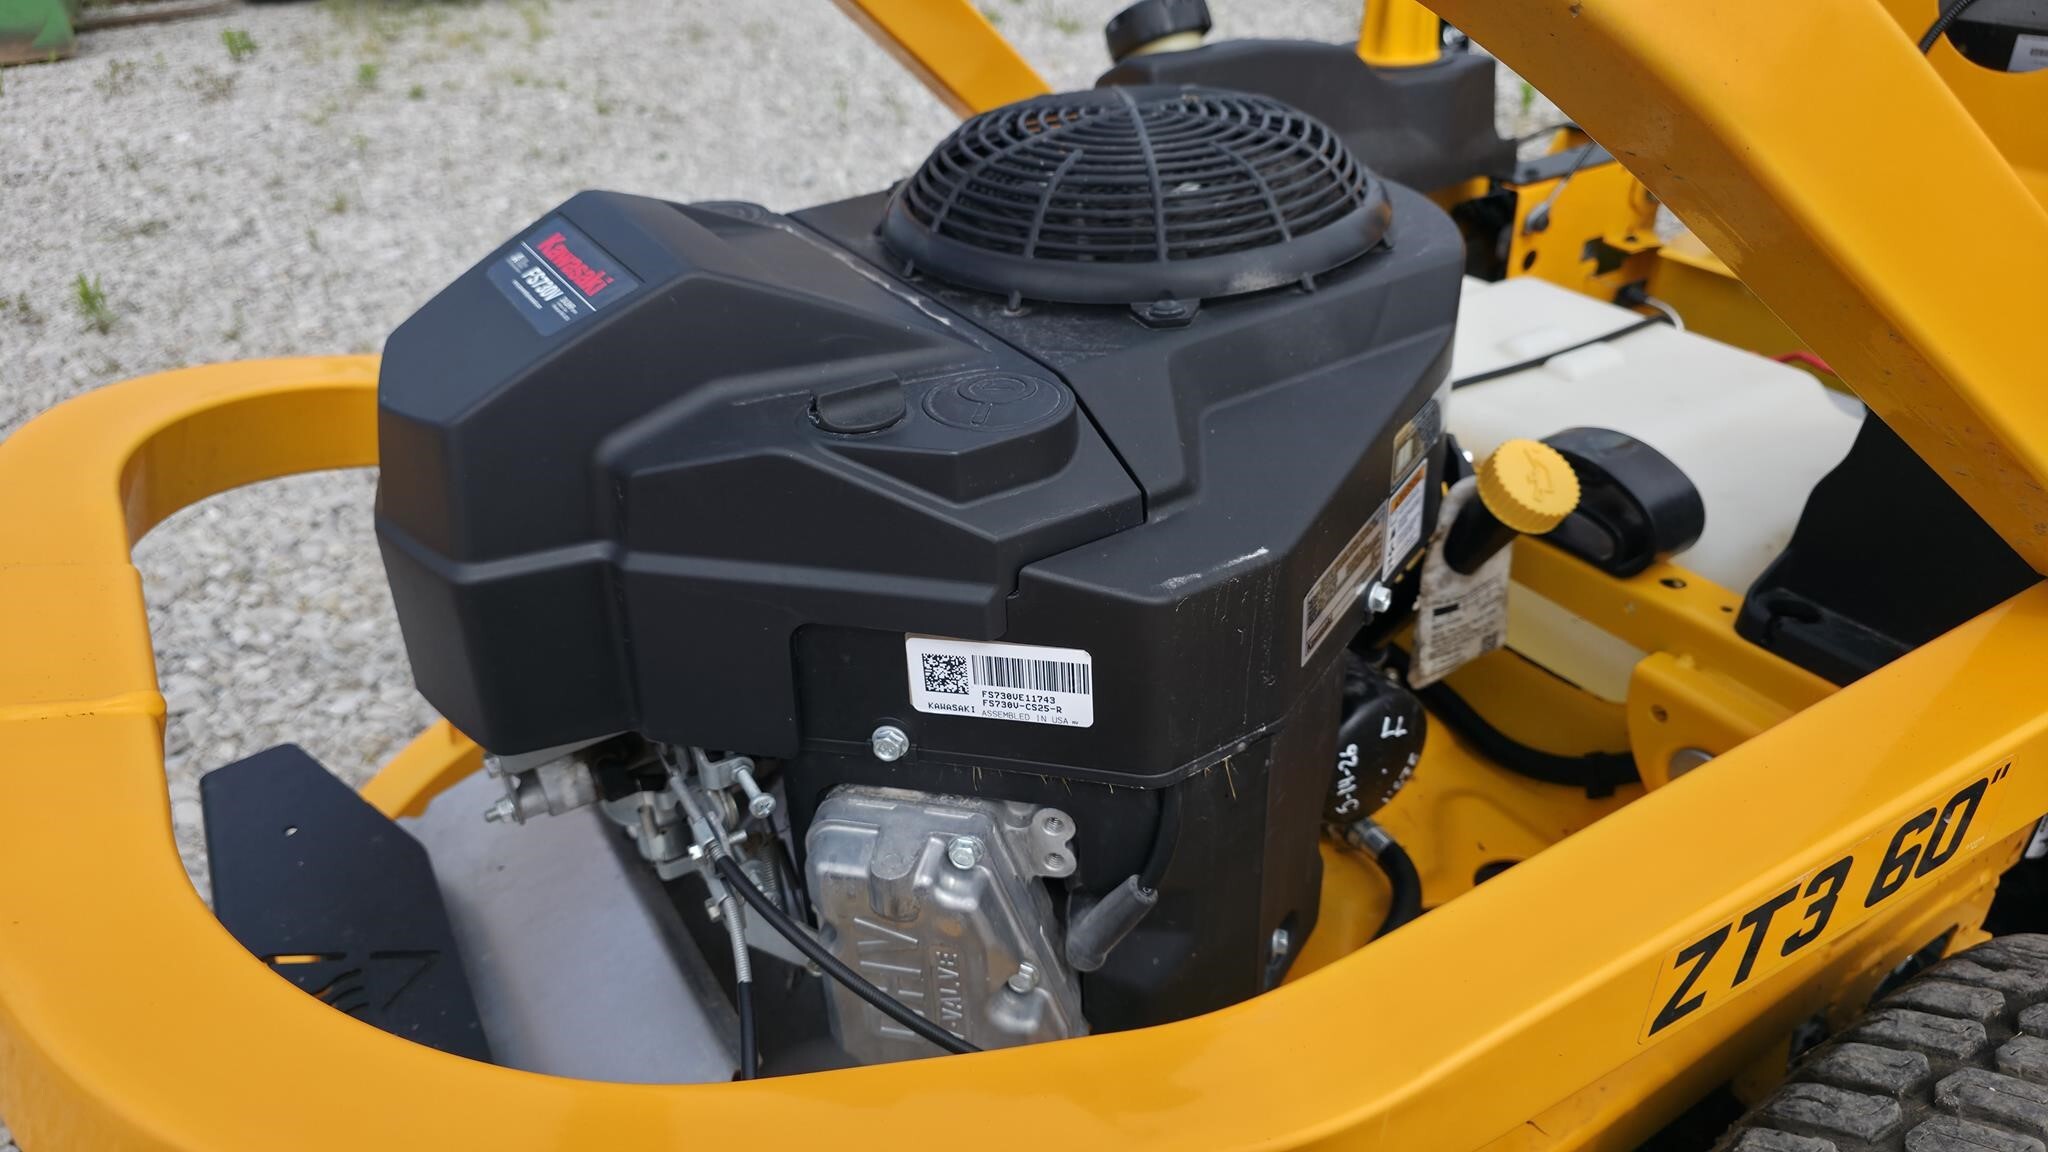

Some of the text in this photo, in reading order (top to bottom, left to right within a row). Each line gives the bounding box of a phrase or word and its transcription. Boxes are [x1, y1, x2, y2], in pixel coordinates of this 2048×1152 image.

[538, 232, 614, 296] Kawasaki
[521, 266, 565, 302] FS730V
[928, 702, 975, 713] KAWASAKI
[982, 691, 1056, 704] FS730VE11743
[983, 700, 1062, 714] FS730V-CS25-R
[982, 711, 1030, 721] ASSEMBLED
[1037, 715, 1047, 723] IN
[1052, 716, 1069, 725] USA
[1335, 743, 1360, 814] 5-14-26
[1648, 856, 1854, 1038] ZT3
